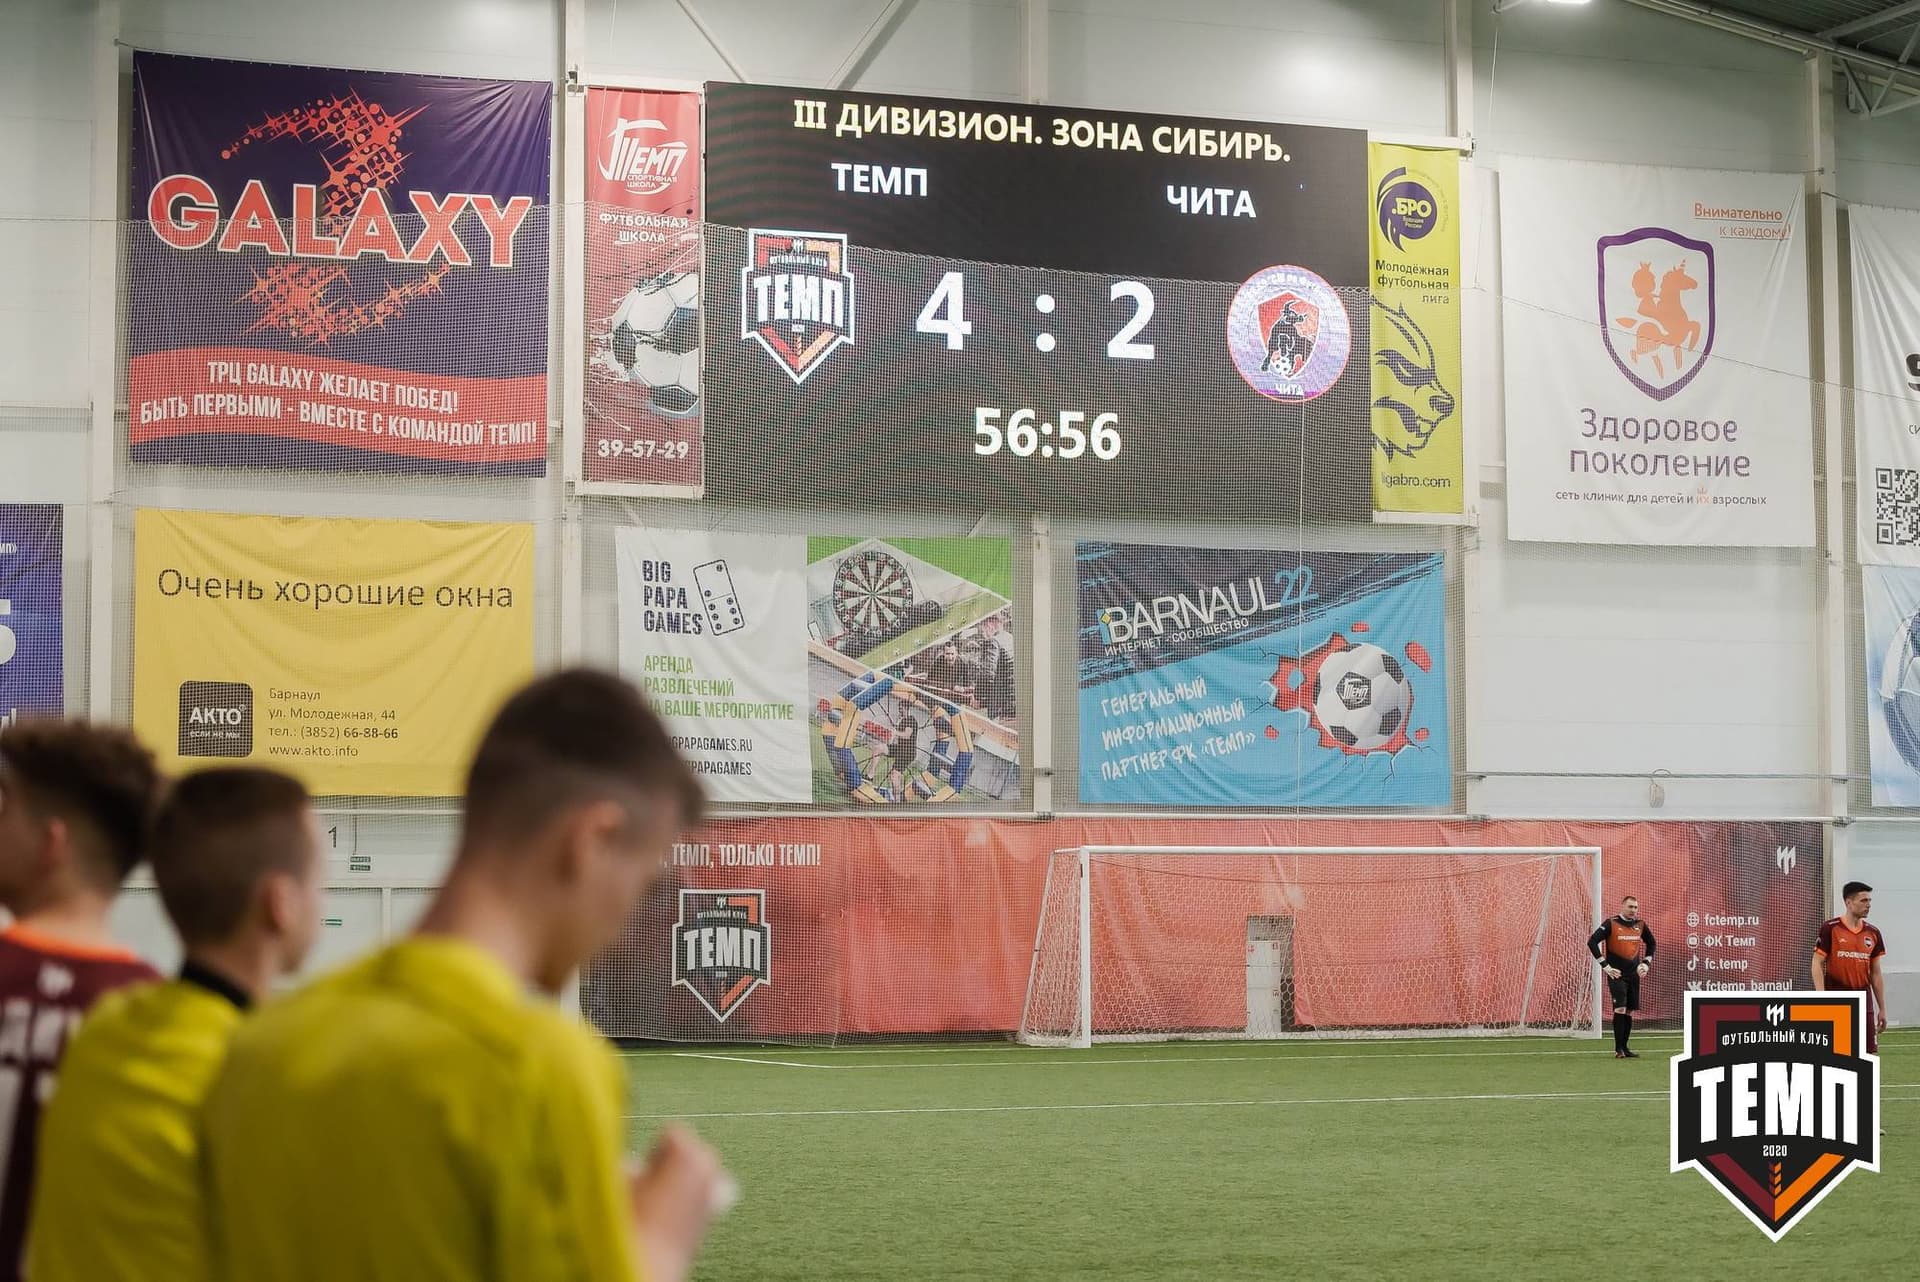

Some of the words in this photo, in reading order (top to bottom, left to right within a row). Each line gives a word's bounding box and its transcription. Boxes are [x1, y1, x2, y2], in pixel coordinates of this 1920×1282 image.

[794, 100, 827, 129] III
[835, 103, 1043, 145] ДИВИЗИОН.
[1052, 118, 1144, 152] ЗОНА
[1152, 126, 1291, 162] СИБИРЬ.
[627, 174, 678, 183] СПОРТИВНАЯ
[627, 181, 657, 189] ШКОЛА
[831, 163, 928, 197] ТЕМП
[1167, 185, 1257, 218] ЧИТА
[1694, 202, 1783, 220] Внимательно
[148, 174, 533, 268] GALAXY
[600, 213, 688, 229] ФУТБОЛЬНАЯ
[1719, 226, 1727, 236] к
[619, 230, 666, 243] ШКОЛА
[1375, 259, 1449, 277] Молодёжная
[1377, 274, 1449, 290] футбольная
[754, 273, 844, 329] ТЕМП
[1422, 293, 1449, 304] лига
[916, 271, 972, 350] 4
[1107, 280, 1155, 360] 2
[208, 361, 241, 386] ТРЦ
[247, 362, 315, 391] GALAXY
[319, 372, 390, 403] ЖЕЛАЕТ
[395, 384, 458, 414] ПОБЕД!
[141, 396, 188, 424] БЫТЬ
[194, 394, 281, 419] ПЕРВЫМИ
[300, 400, 367, 432] ВМЕСТЕ
[372, 412, 383, 434] С
[388, 415, 484, 446] КОМАНДОЙ
[489, 421, 537, 446] ТЕМП!
[1580, 407, 1738, 444] Здоровое
[974, 406, 1121, 460] 56:56
[598, 439, 689, 459] 39-57-29
[1570, 450, 1750, 477] поколение
[1555, 490, 1580, 501] сеть
[1583, 492, 1624, 503] клиник
[1626, 494, 1648, 504] для
[1650, 493, 1687, 504] детей
[1712, 495, 1767, 507] взрослых
[642, 560, 671, 583] BIG
[158, 568, 264, 601] Очень
[275, 580, 425, 610] хорошие
[436, 584, 513, 608] окна
[643, 584, 688, 609] PAPA
[643, 609, 704, 635] GAMES
[1104, 637, 1162, 657] ИНТЕРНЕТ
[1171, 617, 1249, 644] СООБЩЕСТВО
[644, 655, 693, 674] АРЕНДА
[269, 688, 321, 701] Барнаул
[643, 676, 735, 697] РАЗВЛЕЧЕНИЙ
[1101, 675, 1208, 717] ГЕНЕРАЛЬНЫЙ
[268, 708, 286, 720] ул.
[289, 707, 377, 722] Молодежная,
[381, 709, 396, 720] 44
[664, 699, 701, 717] ВАШЕ
[704, 701, 794, 721] МЕРОПРИЯТИЕ
[268, 726, 297, 738] тел.:
[300, 726, 340, 740] (3852)
[343, 728, 399, 740] 66-88-66
[1101, 697, 1246, 750] ИНФОРМАЦИОННЫЙ
[269, 745, 359, 757] www.akto.info
[1101, 748, 1168, 782] ПАРТНЕР
[1171, 743, 1198, 764] ФК
[672, 843, 714, 868] ТЕМП,
[718, 844, 774, 866] ТОЛЬКО
[779, 843, 821, 866] ТЕМП!
[1704, 913, 1759, 928] fctemp.ru
[683, 926, 761, 971] ТЕМП
[1704, 934, 1723, 948] ФК
[1725, 934, 1756, 947] Темп
[1704, 957, 1748, 972] fc.temp
